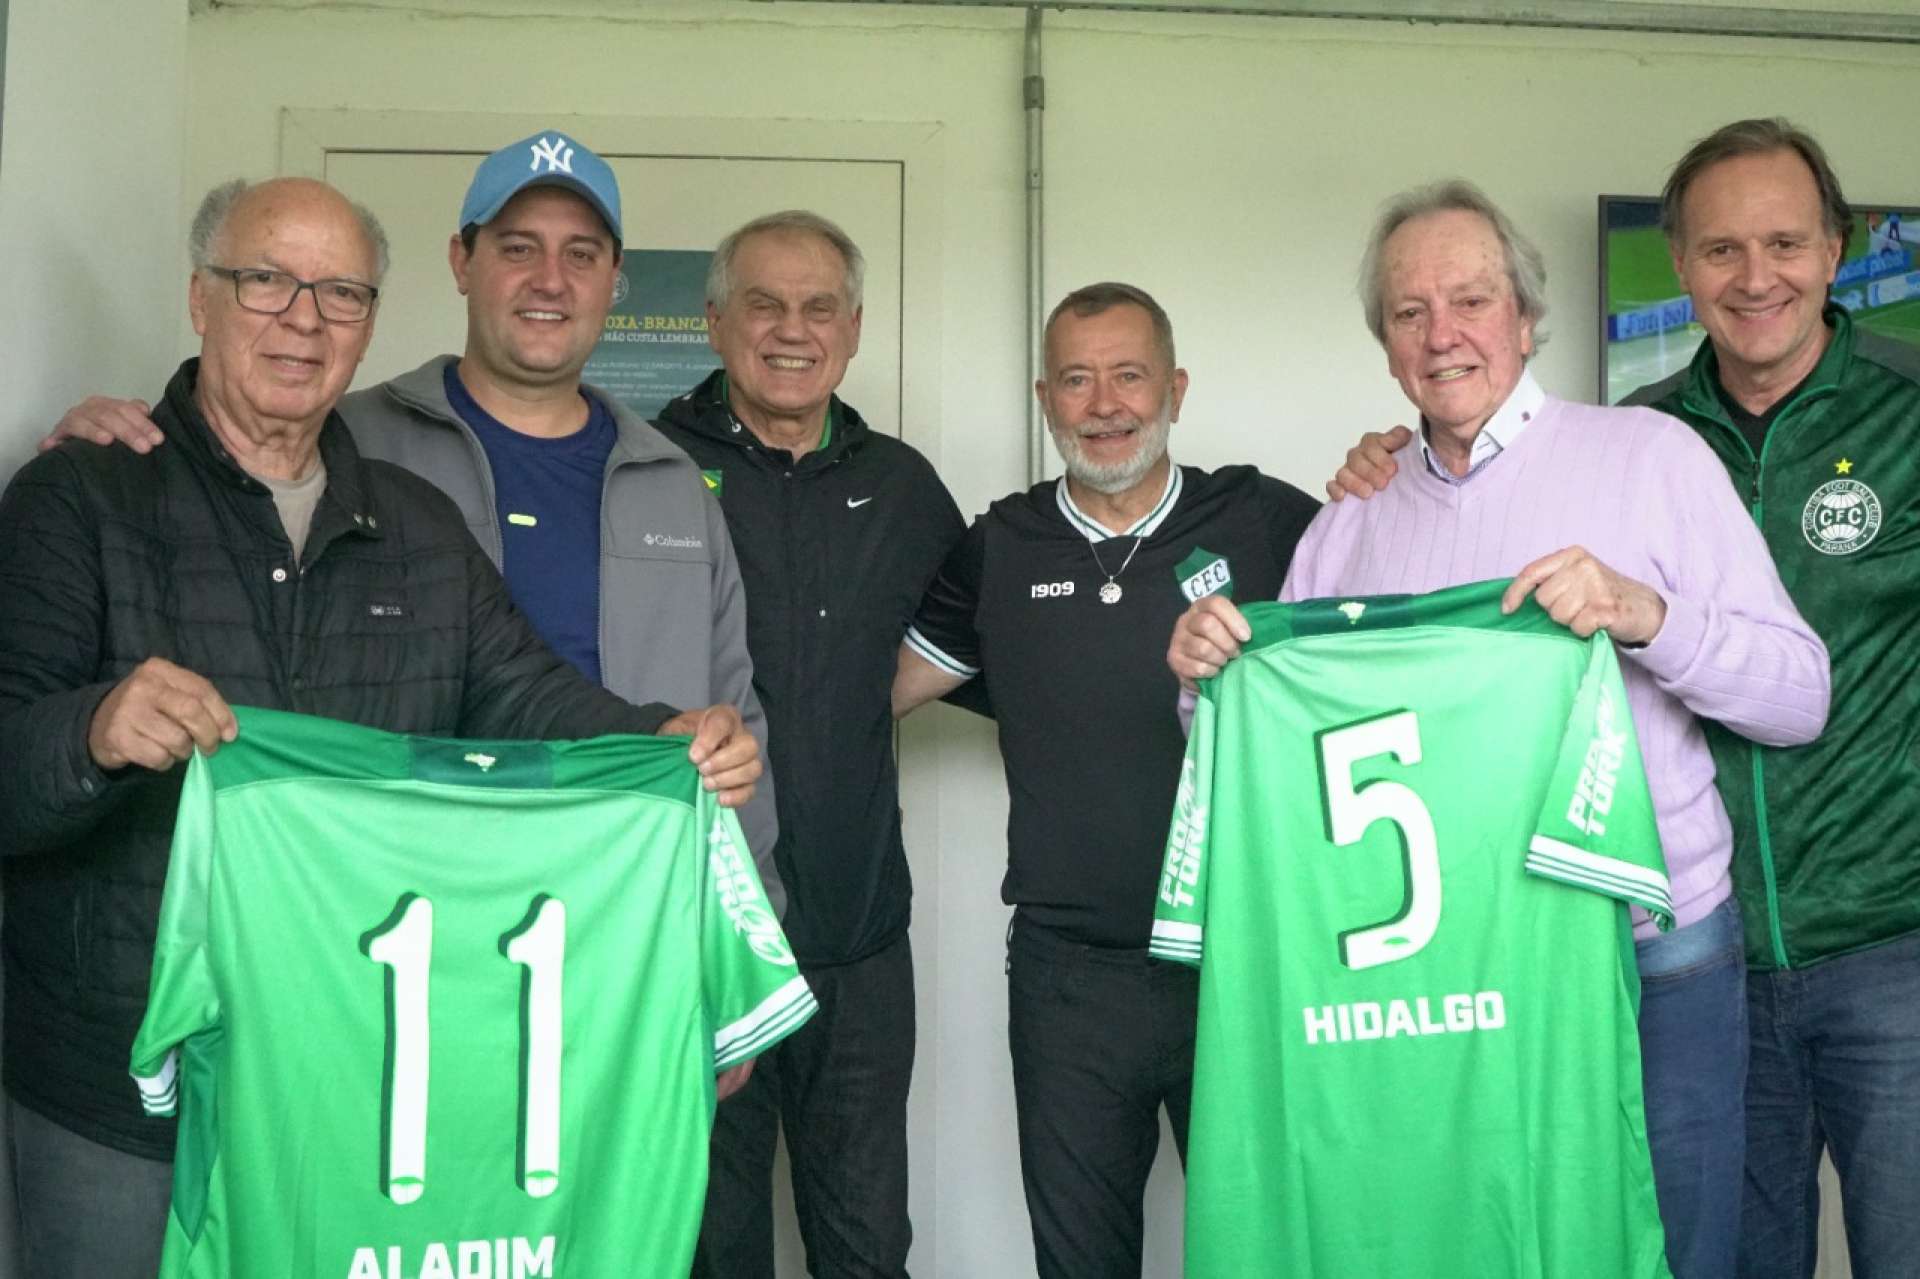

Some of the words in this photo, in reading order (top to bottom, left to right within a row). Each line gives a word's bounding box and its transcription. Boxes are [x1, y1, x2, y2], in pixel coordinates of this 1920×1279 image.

[530, 137, 574, 173] NY
[605, 316, 709, 330] OXA-BRANCA
[627, 333, 658, 343] CUSTA
[1820, 507, 1862, 526] CFC
[1031, 581, 1075, 598] 1909
[1190, 563, 1227, 597] CFC
[1585, 731, 1627, 837] TORK
[1172, 804, 1206, 909] TORK
[1313, 708, 1442, 971] 5
[1161, 819, 1190, 905] PRO
[1303, 990, 1506, 1045] HIDALGO
[358, 891, 566, 1204] 11
[347, 1235, 556, 1279] ALADIM
